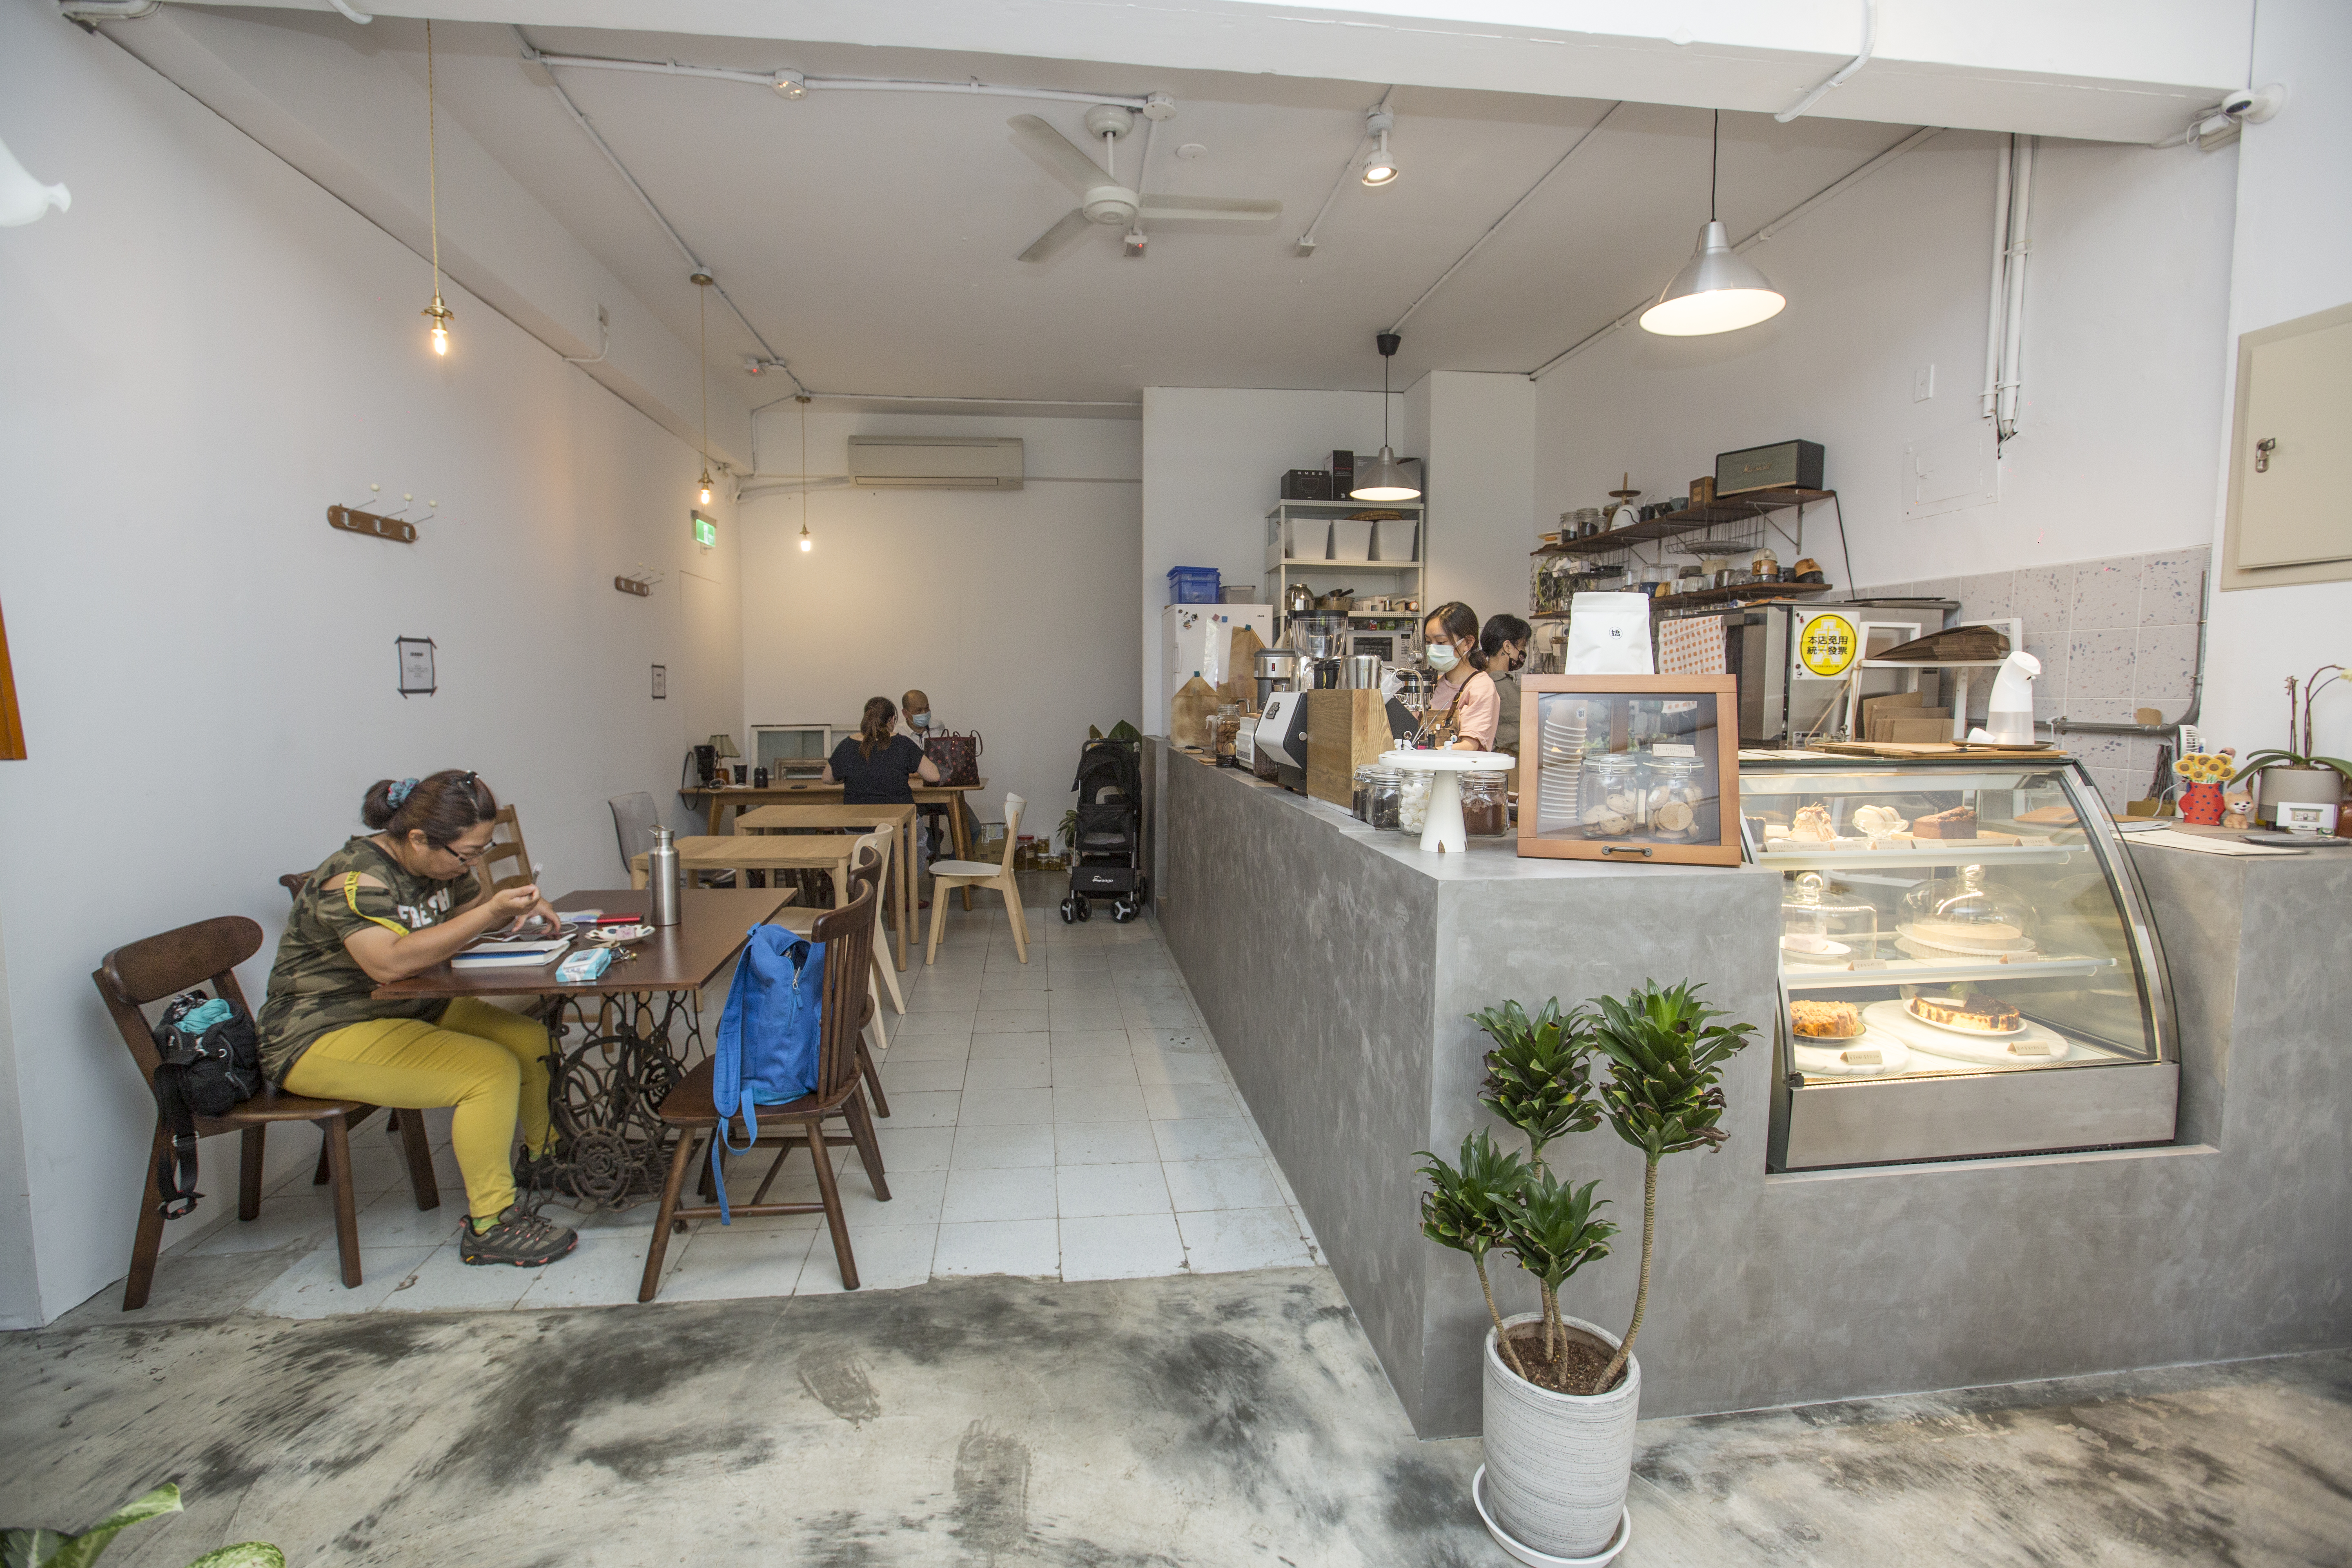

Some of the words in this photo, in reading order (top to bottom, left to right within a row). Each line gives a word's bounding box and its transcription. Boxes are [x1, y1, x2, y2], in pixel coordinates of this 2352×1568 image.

[1808, 636, 1848, 645] 本店免用
[1807, 646, 1848, 655] 統一發票
